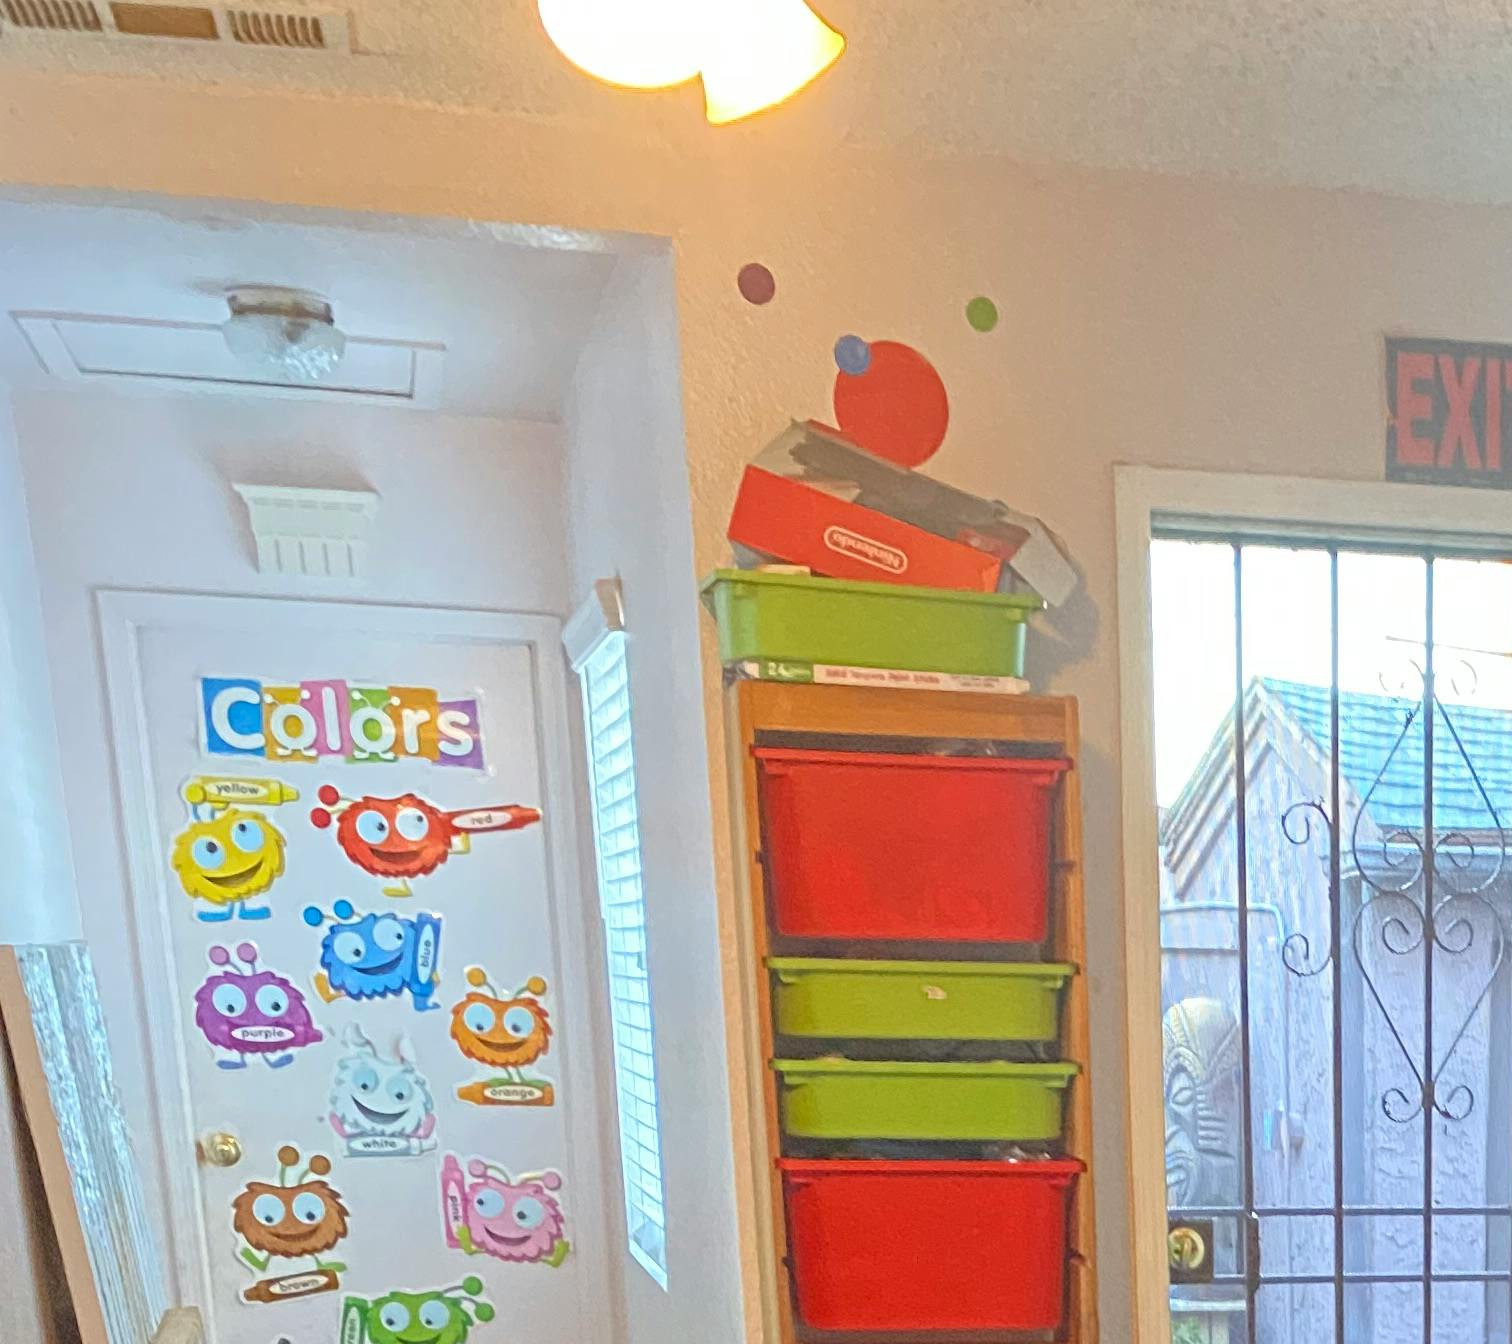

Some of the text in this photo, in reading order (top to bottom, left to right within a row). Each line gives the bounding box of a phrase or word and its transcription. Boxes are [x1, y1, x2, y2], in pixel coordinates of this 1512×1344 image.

[832, 529, 902, 571] Nintendo
[211, 686, 474, 757] Colors
[215, 781, 261, 796] yellow
[470, 813, 493, 826] red
[419, 939, 433, 968] blue
[240, 1027, 286, 1040] purple
[489, 1086, 536, 1099] orange
[362, 1137, 398, 1150] white
[447, 1194, 460, 1223] pink
[279, 1277, 320, 1293] brown
